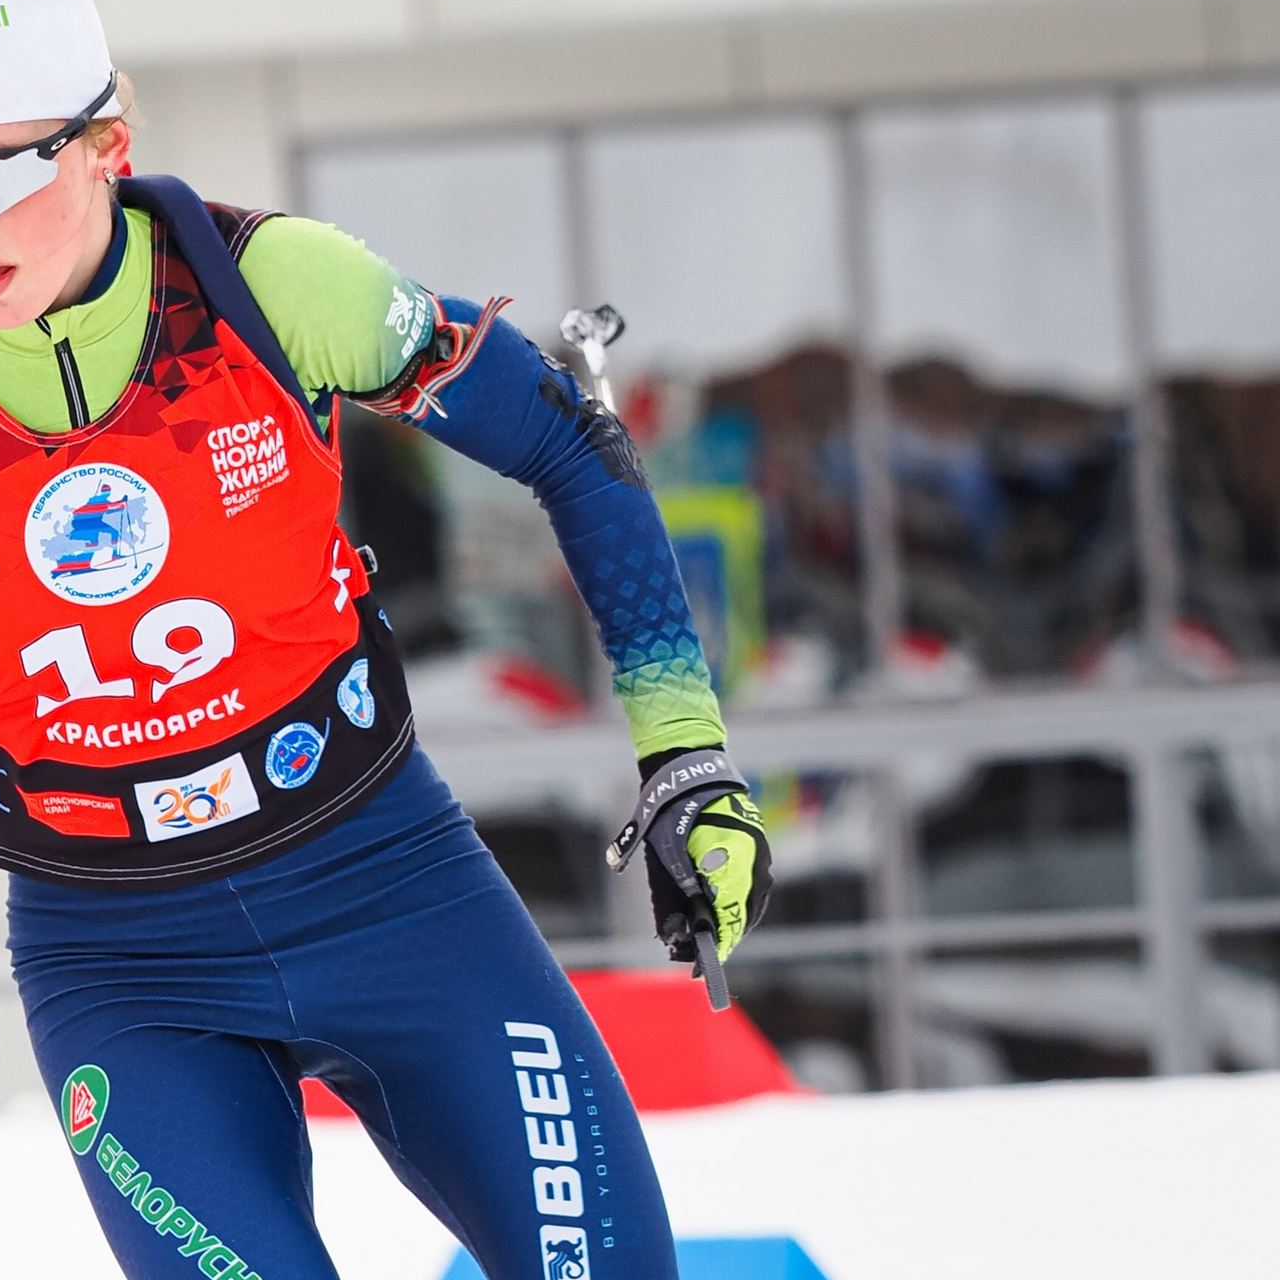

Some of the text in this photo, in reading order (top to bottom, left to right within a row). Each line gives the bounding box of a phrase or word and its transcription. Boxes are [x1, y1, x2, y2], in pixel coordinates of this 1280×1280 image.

[401, 292, 426, 360] BEEU
[207, 415, 275, 451] СПОРТ
[211, 427, 284, 473] НОРМА
[32, 468, 147, 519] ПЕРВЕНСТВО РОССИИ
[216, 447, 287, 495] ЖИЗНИ
[225, 493, 259, 519] ПРОЕКТ
[64, 586, 129, 599] Красноярск
[131, 562, 153, 587] 2023
[19, 598, 236, 719] 19
[45, 688, 247, 749] КРАСНОЯРСК
[43, 796, 115, 810] КРАСНОЯРСКИЙ
[44, 805, 71, 814] КРАЙ
[504, 1021, 585, 1218] BEEU
[574, 1053, 614, 1248] BE YOURSELF
